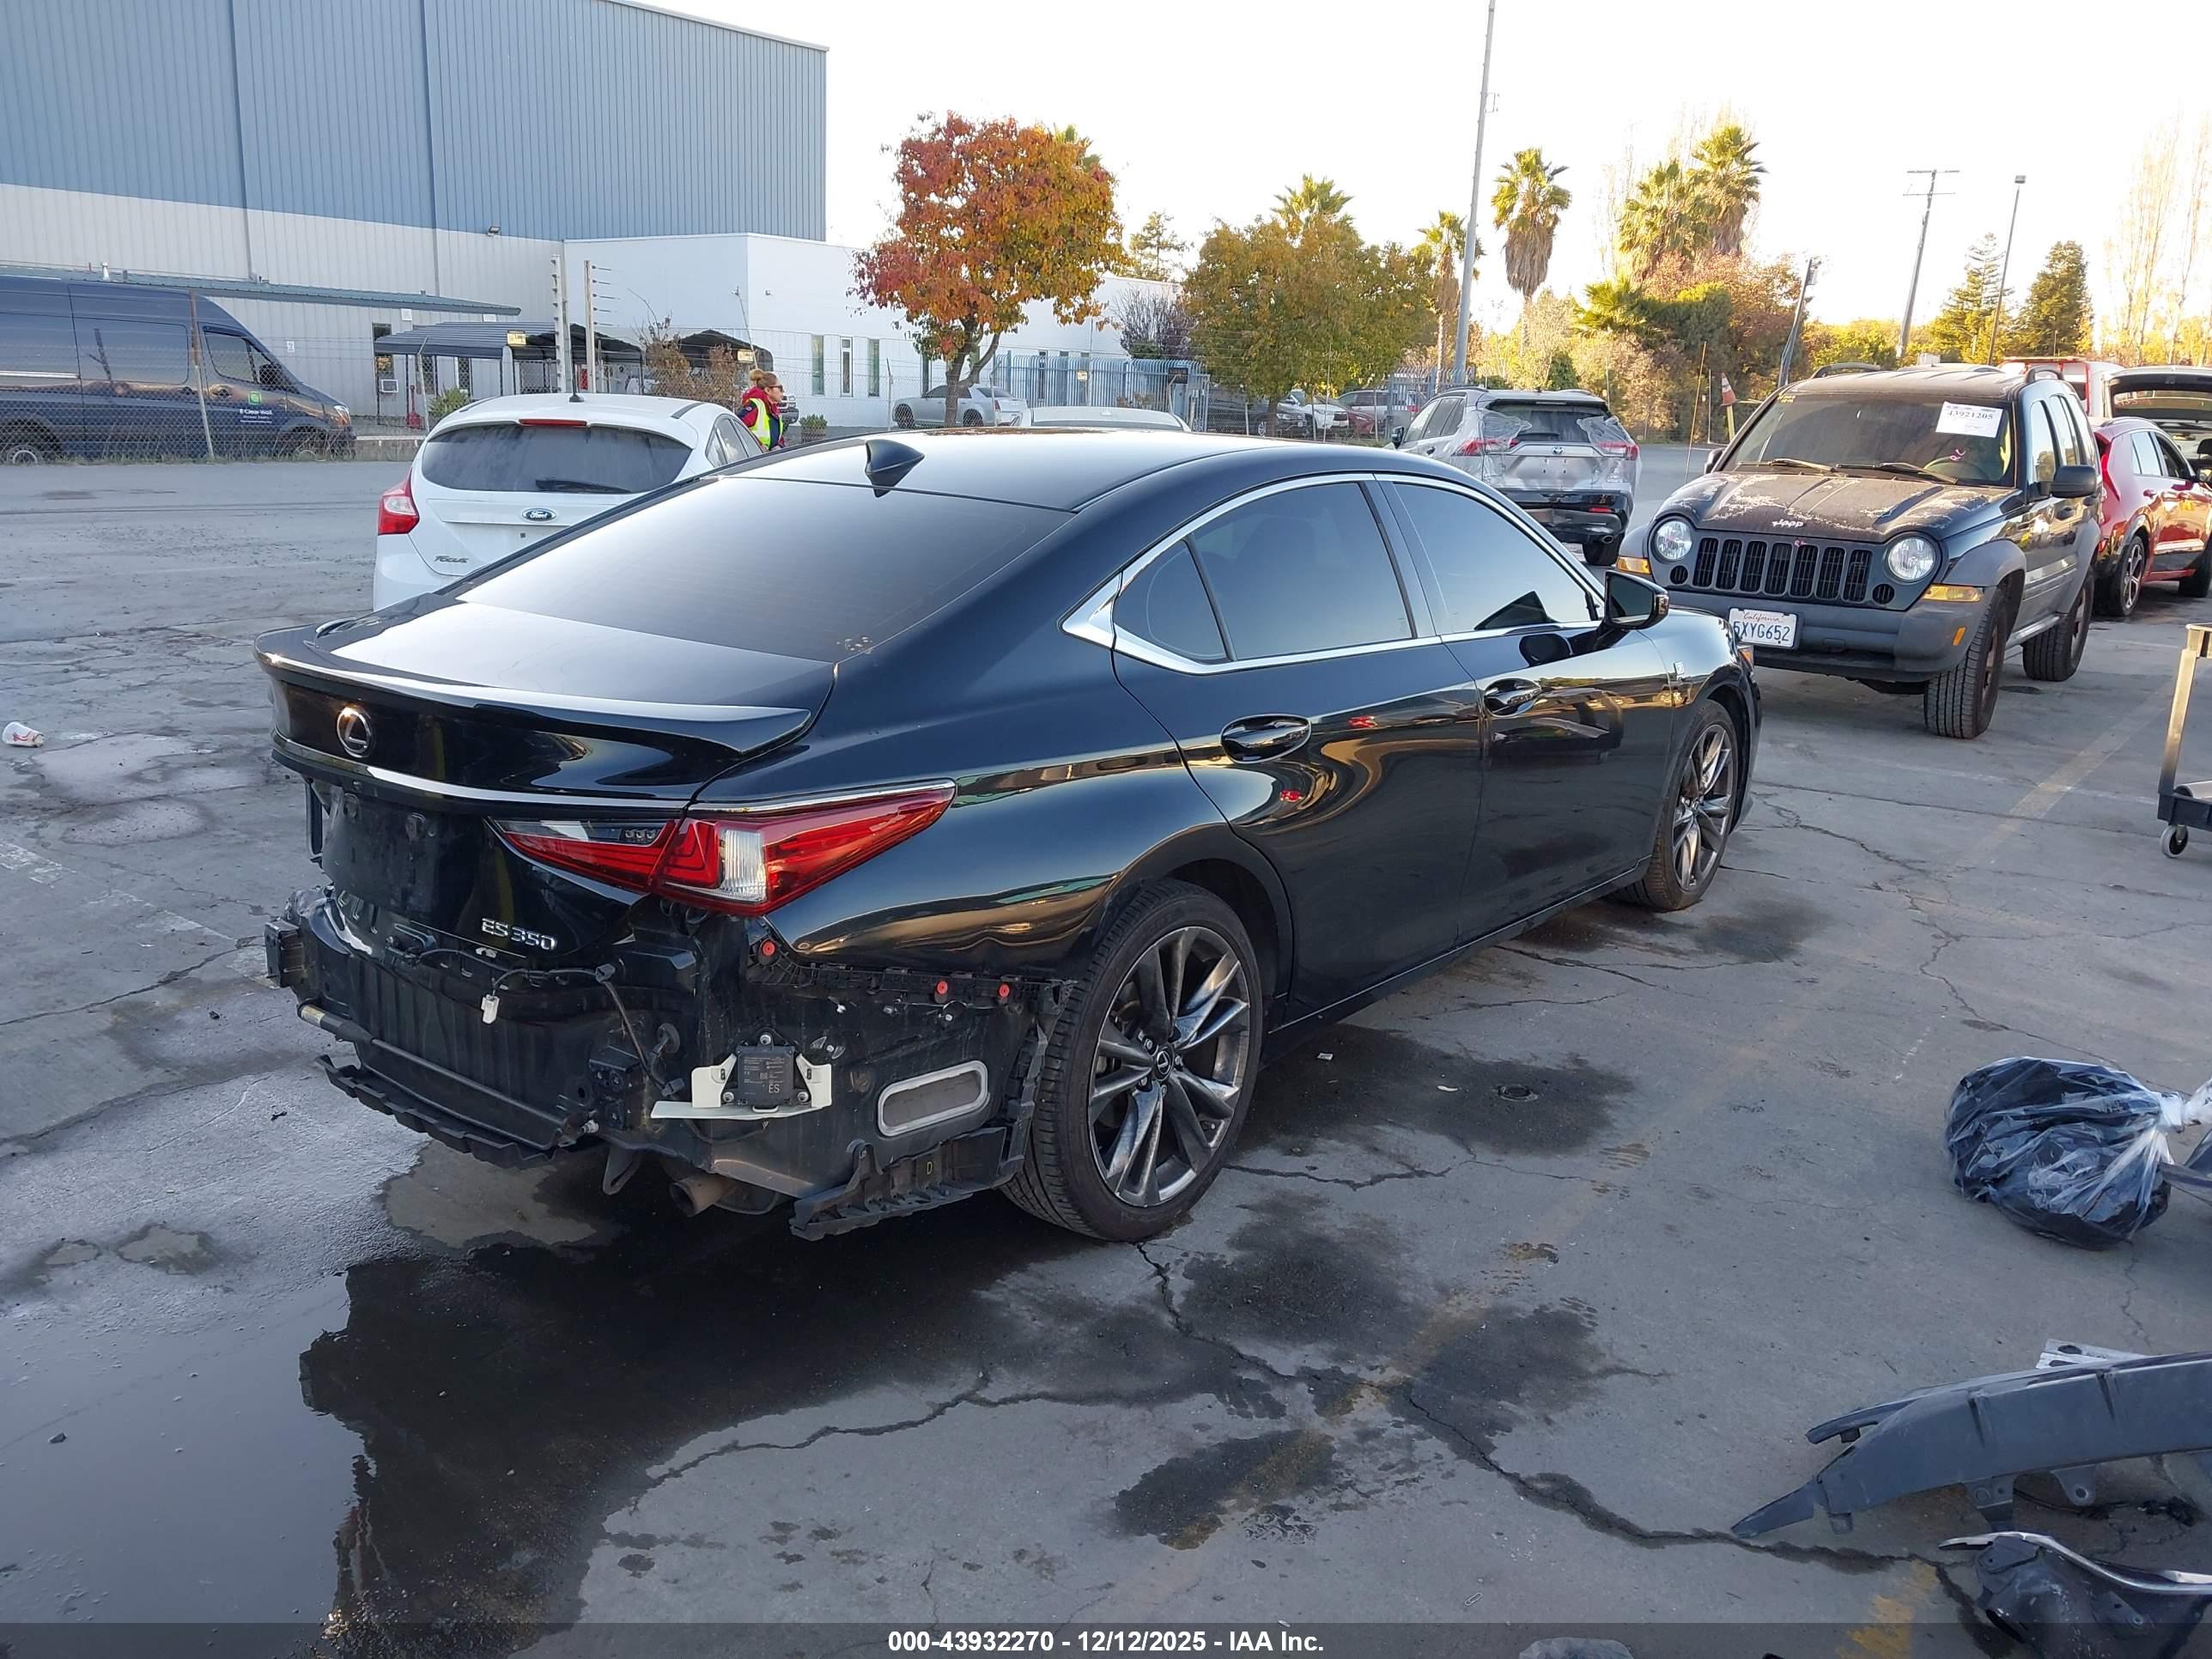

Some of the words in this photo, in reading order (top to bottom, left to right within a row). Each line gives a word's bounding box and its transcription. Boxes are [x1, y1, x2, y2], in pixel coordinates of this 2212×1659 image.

[1744, 611, 1780, 623] California
[482, 917, 509, 937] ES
[510, 926, 557, 951] 350
[769, 1084, 781, 1093] ES
